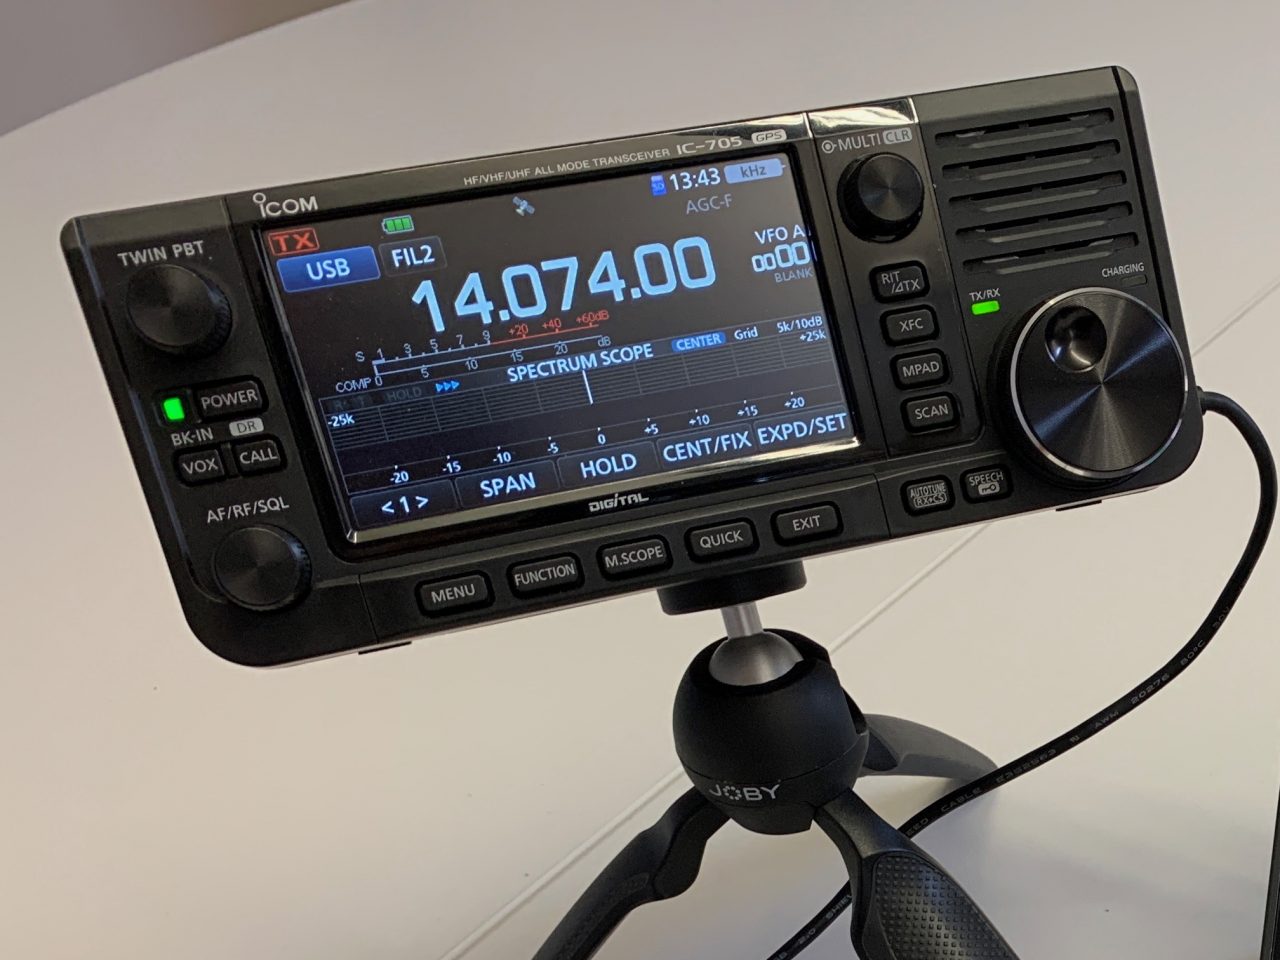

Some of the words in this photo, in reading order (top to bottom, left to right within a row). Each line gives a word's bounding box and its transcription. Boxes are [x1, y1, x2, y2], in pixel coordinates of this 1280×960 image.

[838, 134, 880, 152] MULTI
[885, 129, 910, 143] CLR
[464, 168, 531, 185] HF/VHF/UHF
[534, 164, 554, 176] ALL
[557, 159, 590, 173] MODE
[591, 148, 670, 169] TRANSCEIVER
[676, 136, 742, 155] IC-705
[755, 130, 783, 142] GPS
[669, 169, 721, 191] 13:43
[740, 164, 768, 178] kHz
[685, 195, 733, 214] AGC-F
[273, 231, 314, 252] TX
[754, 228, 789, 245] VFO
[117, 245, 168, 267] TWIN
[172, 239, 205, 260] PBT
[391, 244, 435, 267] FIL2
[305, 257, 351, 281] USB
[774, 267, 814, 283] BLANK
[881, 271, 899, 284] RIT
[1101, 262, 1145, 277] CHARGING
[411, 236, 717, 333] 14.074.00
[969, 288, 1001, 301] TX/RX
[900, 318, 924, 333] XFC
[507, 353, 598, 382] SPECTRUM
[600, 344, 653, 366] SCOPE
[676, 333, 721, 351] CENTER
[734, 327, 758, 340] Grid
[776, 316, 823, 333] 5k/10dB
[327, 414, 355, 427] -25k
[799, 330, 826, 342] +25k
[902, 361, 940, 377] MPAD
[335, 378, 371, 393] COMP
[201, 388, 258, 410] POWER
[915, 404, 949, 420] SCAN
[170, 426, 214, 447] BK-IN
[236, 419, 257, 434] DR
[390, 471, 409, 483] -20
[442, 462, 461, 473] -15
[493, 453, 511, 464] -10
[548, 443, 559, 454] -5
[737, 406, 758, 417] +15
[784, 397, 805, 409] +20
[183, 455, 219, 476] VOX
[239, 445, 277, 464] CALL
[479, 472, 536, 498] SPAN
[580, 453, 637, 479] HOLD
[662, 430, 752, 463] CENT/FIX
[757, 412, 847, 446] EXPD/SET
[910, 482, 946, 498] AUTOTUNE
[969, 472, 1003, 486] SPEECH
[206, 496, 290, 523] AF/RF/SQL
[431, 584, 476, 604] MENU
[514, 563, 575, 587] FUNCTION
[605, 545, 664, 569] M.SCOPE
[700, 530, 744, 549] QUICK
[792, 515, 821, 531] EXIT
[1131, 673, 1170, 704] 20276
[708, 781, 781, 802] JOBY
